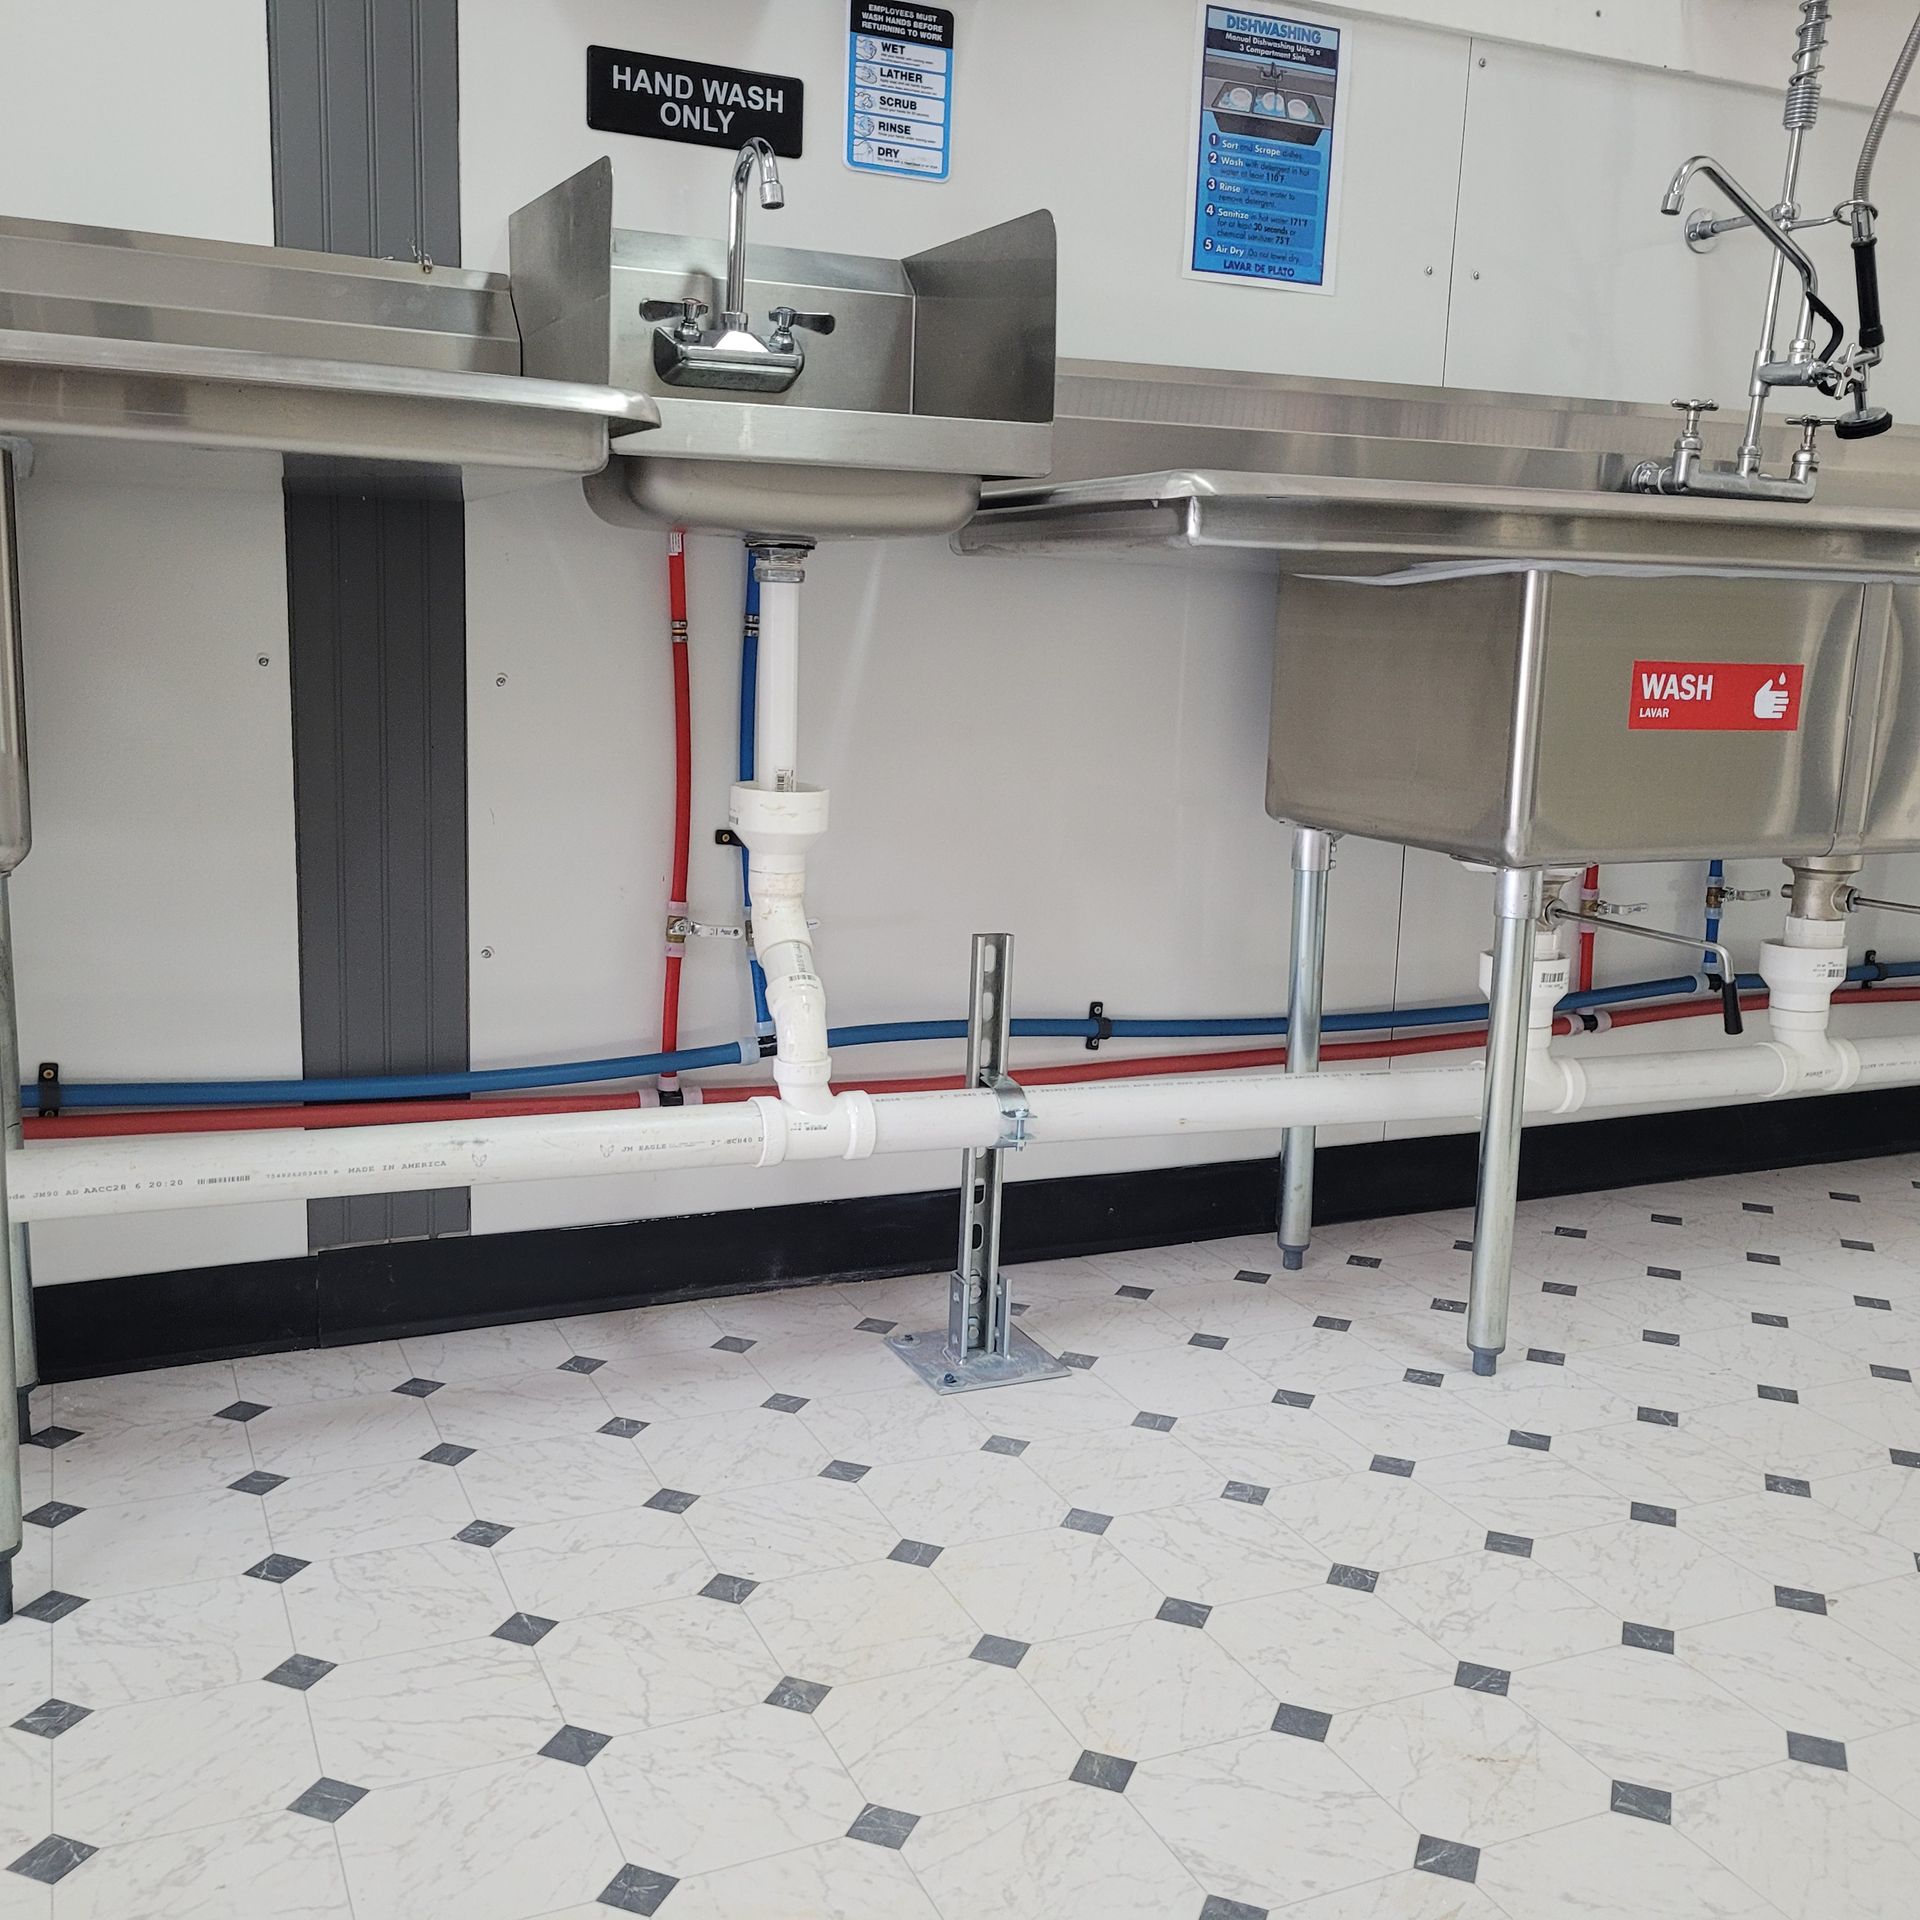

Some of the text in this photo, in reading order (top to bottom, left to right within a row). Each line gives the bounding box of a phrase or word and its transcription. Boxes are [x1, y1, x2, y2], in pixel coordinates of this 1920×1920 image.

[861, 12, 943, 32] WASH HANDS BEFORE
[868, 4, 937, 22] EMPLOYEES MUST
[861, 21, 942, 41] RETURNING TO WORK
[1226, 14, 1321, 44] DISHWASHING
[881, 42, 905, 55] WET
[1225, 32, 1251, 43] Manual
[1252, 36, 1294, 51] Dishwashing
[1296, 45, 1314, 55] Using
[1246, 45, 1291, 59] Compartment
[1292, 53, 1306, 62] Sink
[880, 67, 923, 83] LATHER
[612, 64, 784, 114] HAND WASH
[879, 96, 917, 110] SCRUB
[660, 102, 735, 134] ONLY
[878, 121, 911, 135] RINSE
[877, 147, 900, 159] DRY
[1221, 140, 1239, 150] Sort
[1254, 145, 1281, 157] Scrape
[1210, 152, 1217, 164] 2
[1221, 157, 1243, 167] Wash
[1261, 161, 1290, 174] detergent
[1300, 167, 1310, 176] hot
[1208, 178, 1216, 190] 3
[1219, 182, 1240, 193] Rinse
[1250, 187, 1268, 196] clean
[1269, 191, 1287, 199] water
[1289, 192, 1295, 200] to
[1206, 204, 1214, 215] 4
[1217, 208, 1249, 220] Sanitize
[1217, 229, 1246, 239] chemical
[1264, 225, 1288, 235] seconds
[1204, 239, 1212, 250] 5
[1215, 244, 1228, 254] Air
[1230, 246, 1245, 257] Dry
[1223, 259, 1295, 277] LAVAR DE PLATO
[1641, 673, 1714, 700] WASH
[1639, 707, 1670, 718] LAVAR
[638, 1143, 667, 1152] EAGLE
[33, 1190, 58, 1199] JM90
[149, 1179, 184, 1189] 20:20
[348, 1165, 375, 1174] MADE
[401, 1160, 447, 1170] AMERICA
